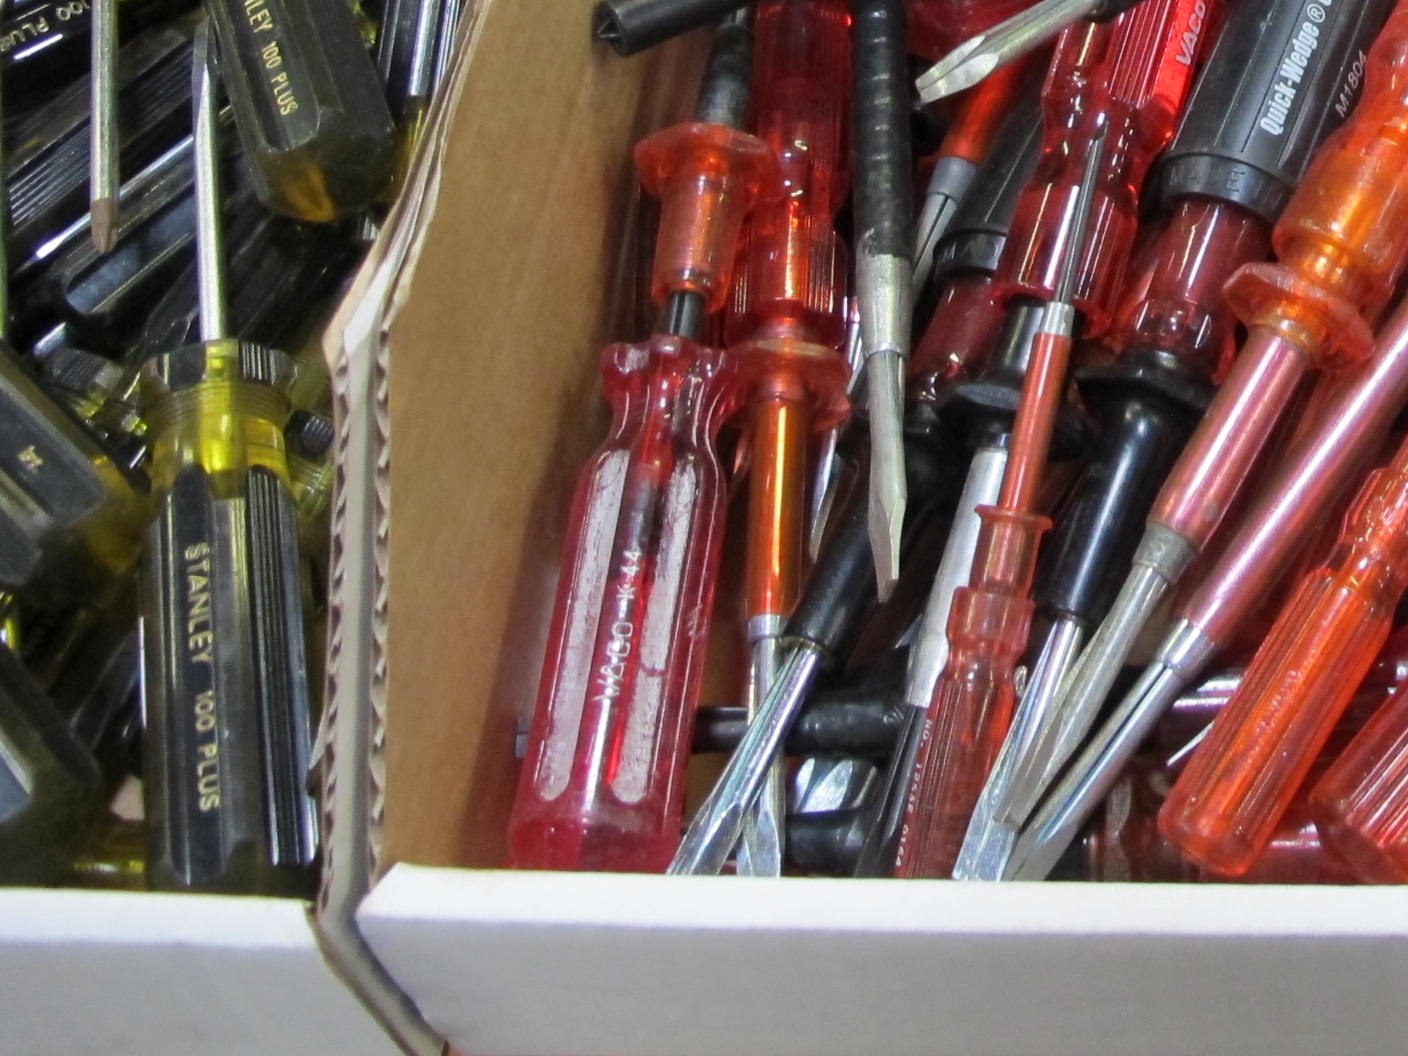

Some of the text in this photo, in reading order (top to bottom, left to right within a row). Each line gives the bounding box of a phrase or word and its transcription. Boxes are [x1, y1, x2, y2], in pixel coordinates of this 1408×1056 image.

[261, 40, 283, 69] 100
[271, 71, 299, 117] PLUS
[1260, 20, 1321, 137] Quick-Wedge
[185, 542, 221, 812] STANLEY 100 PLUS
